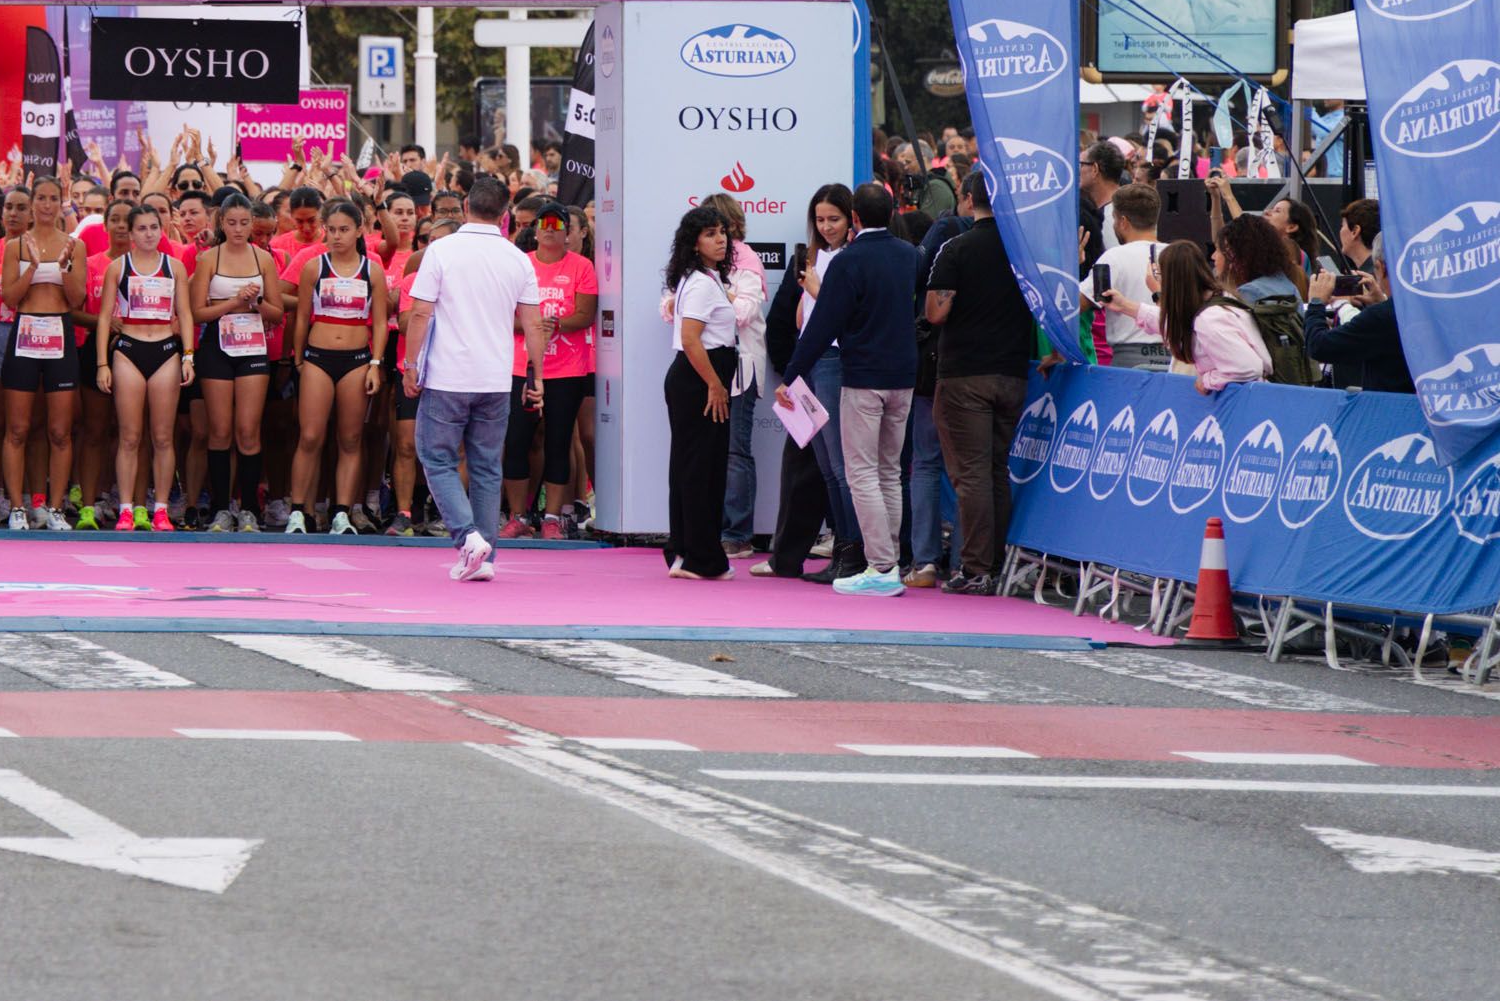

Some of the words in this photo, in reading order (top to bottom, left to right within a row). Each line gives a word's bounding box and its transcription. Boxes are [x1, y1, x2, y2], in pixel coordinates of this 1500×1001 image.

[124, 44, 270, 81] OYSHO
[689, 43, 787, 64] ASTURIANA
[301, 98, 345, 110] OYSHO
[678, 106, 797, 131] OYSHO
[237, 122, 346, 140] CORREDORAS
[1349, 467, 1442, 516] ASTURIANA
